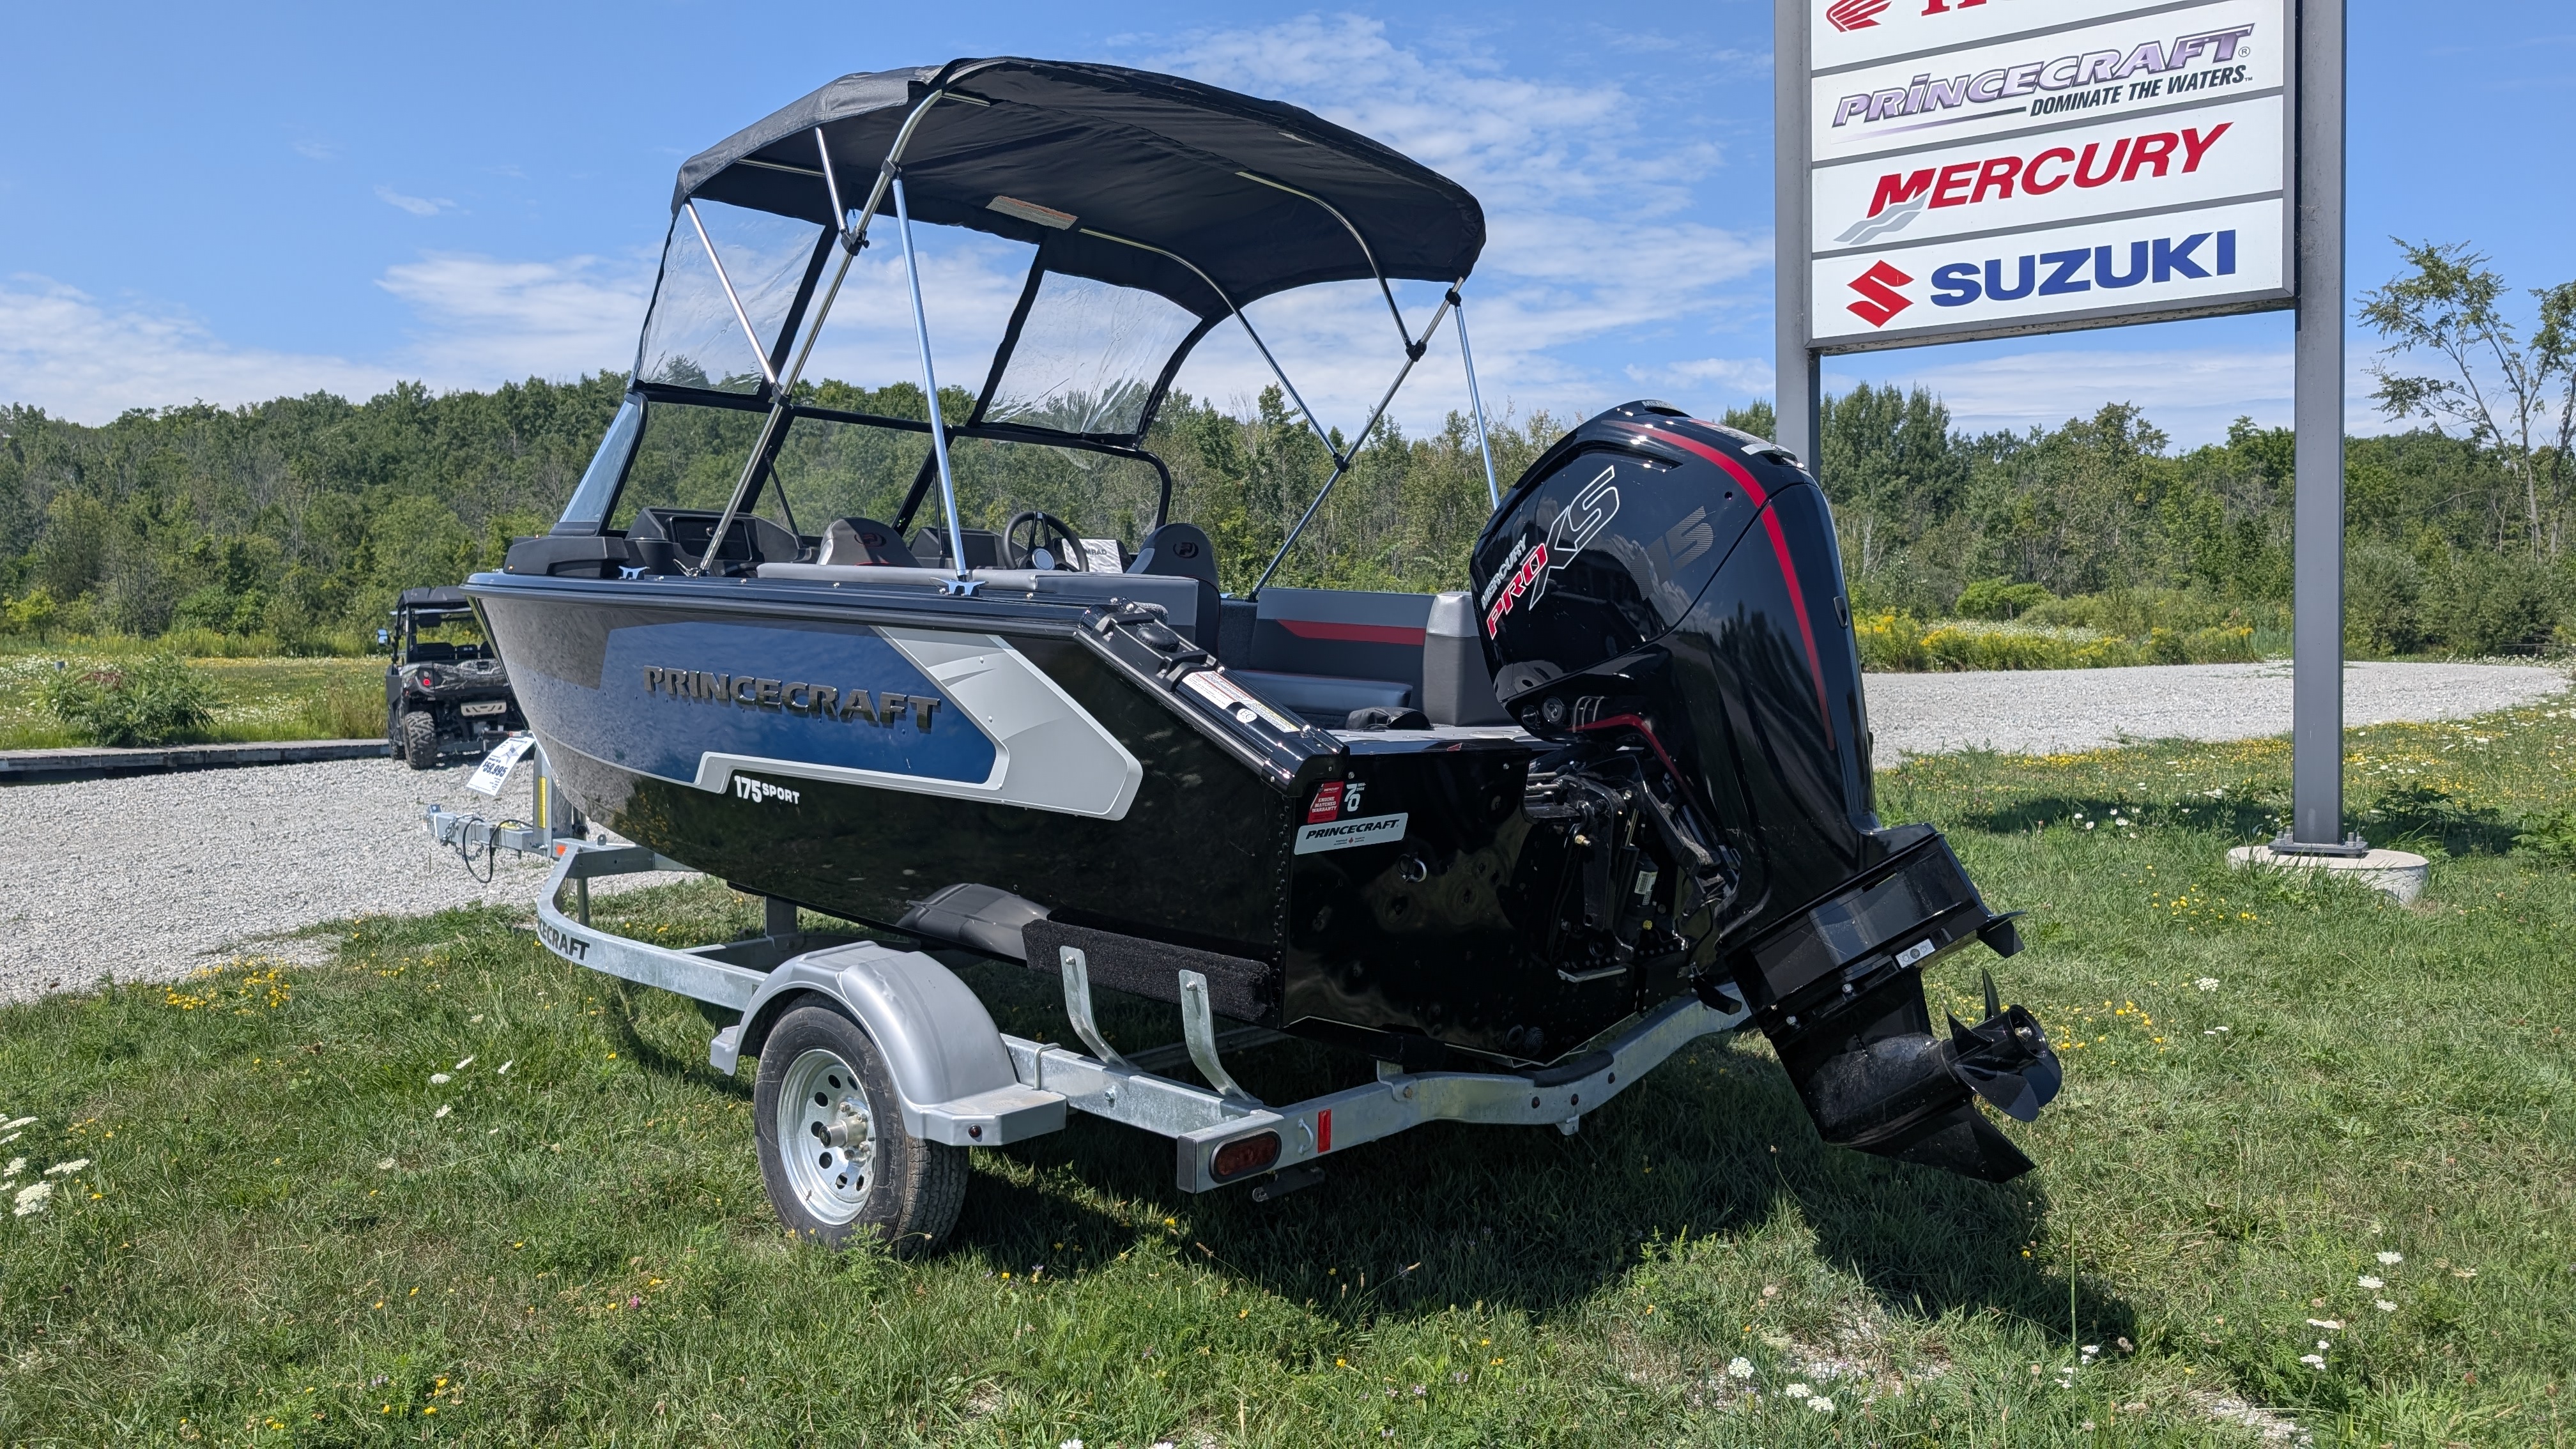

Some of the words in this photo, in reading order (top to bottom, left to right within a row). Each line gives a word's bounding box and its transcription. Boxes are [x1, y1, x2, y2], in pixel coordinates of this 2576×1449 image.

[1832, 22, 2255, 127] PRINCECRAFT
[2030, 85, 2124, 117] DOMINATE
[2128, 79, 2163, 101] THE
[1866, 121, 2235, 218] MERCURY
[1930, 229, 2236, 307] SUZUKI
[1480, 532, 1527, 611] MERCURY
[1486, 542, 1548, 641] PRO
[1529, 464, 1620, 611] XS
[643, 664, 942, 731] PRINCECRAFT
[734, 775, 762, 803] 175
[762, 782, 800, 804] SPORT
[1305, 819, 1400, 839] PRINCECRAFT
[538, 917, 590, 961] CECRAFT
